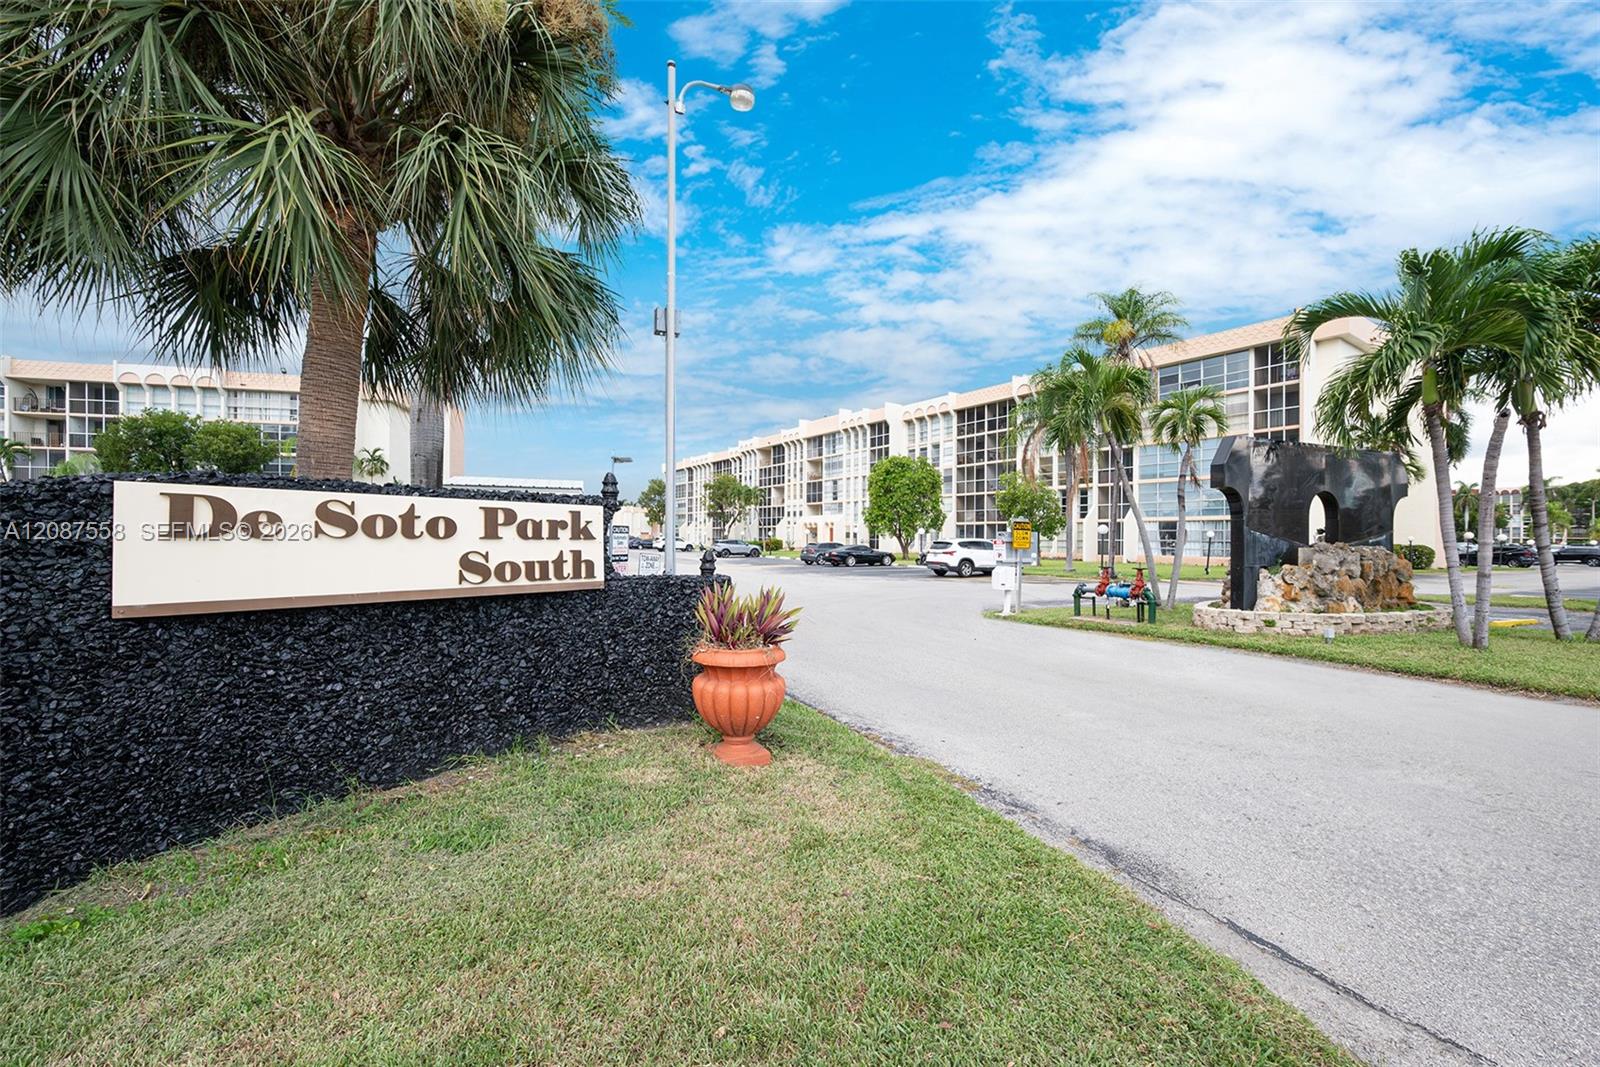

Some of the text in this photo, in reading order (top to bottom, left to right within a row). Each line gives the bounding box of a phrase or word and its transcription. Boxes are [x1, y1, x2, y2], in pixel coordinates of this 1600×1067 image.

[160, 492, 596, 541] De Soto Park
[459, 550, 597, 585] South
